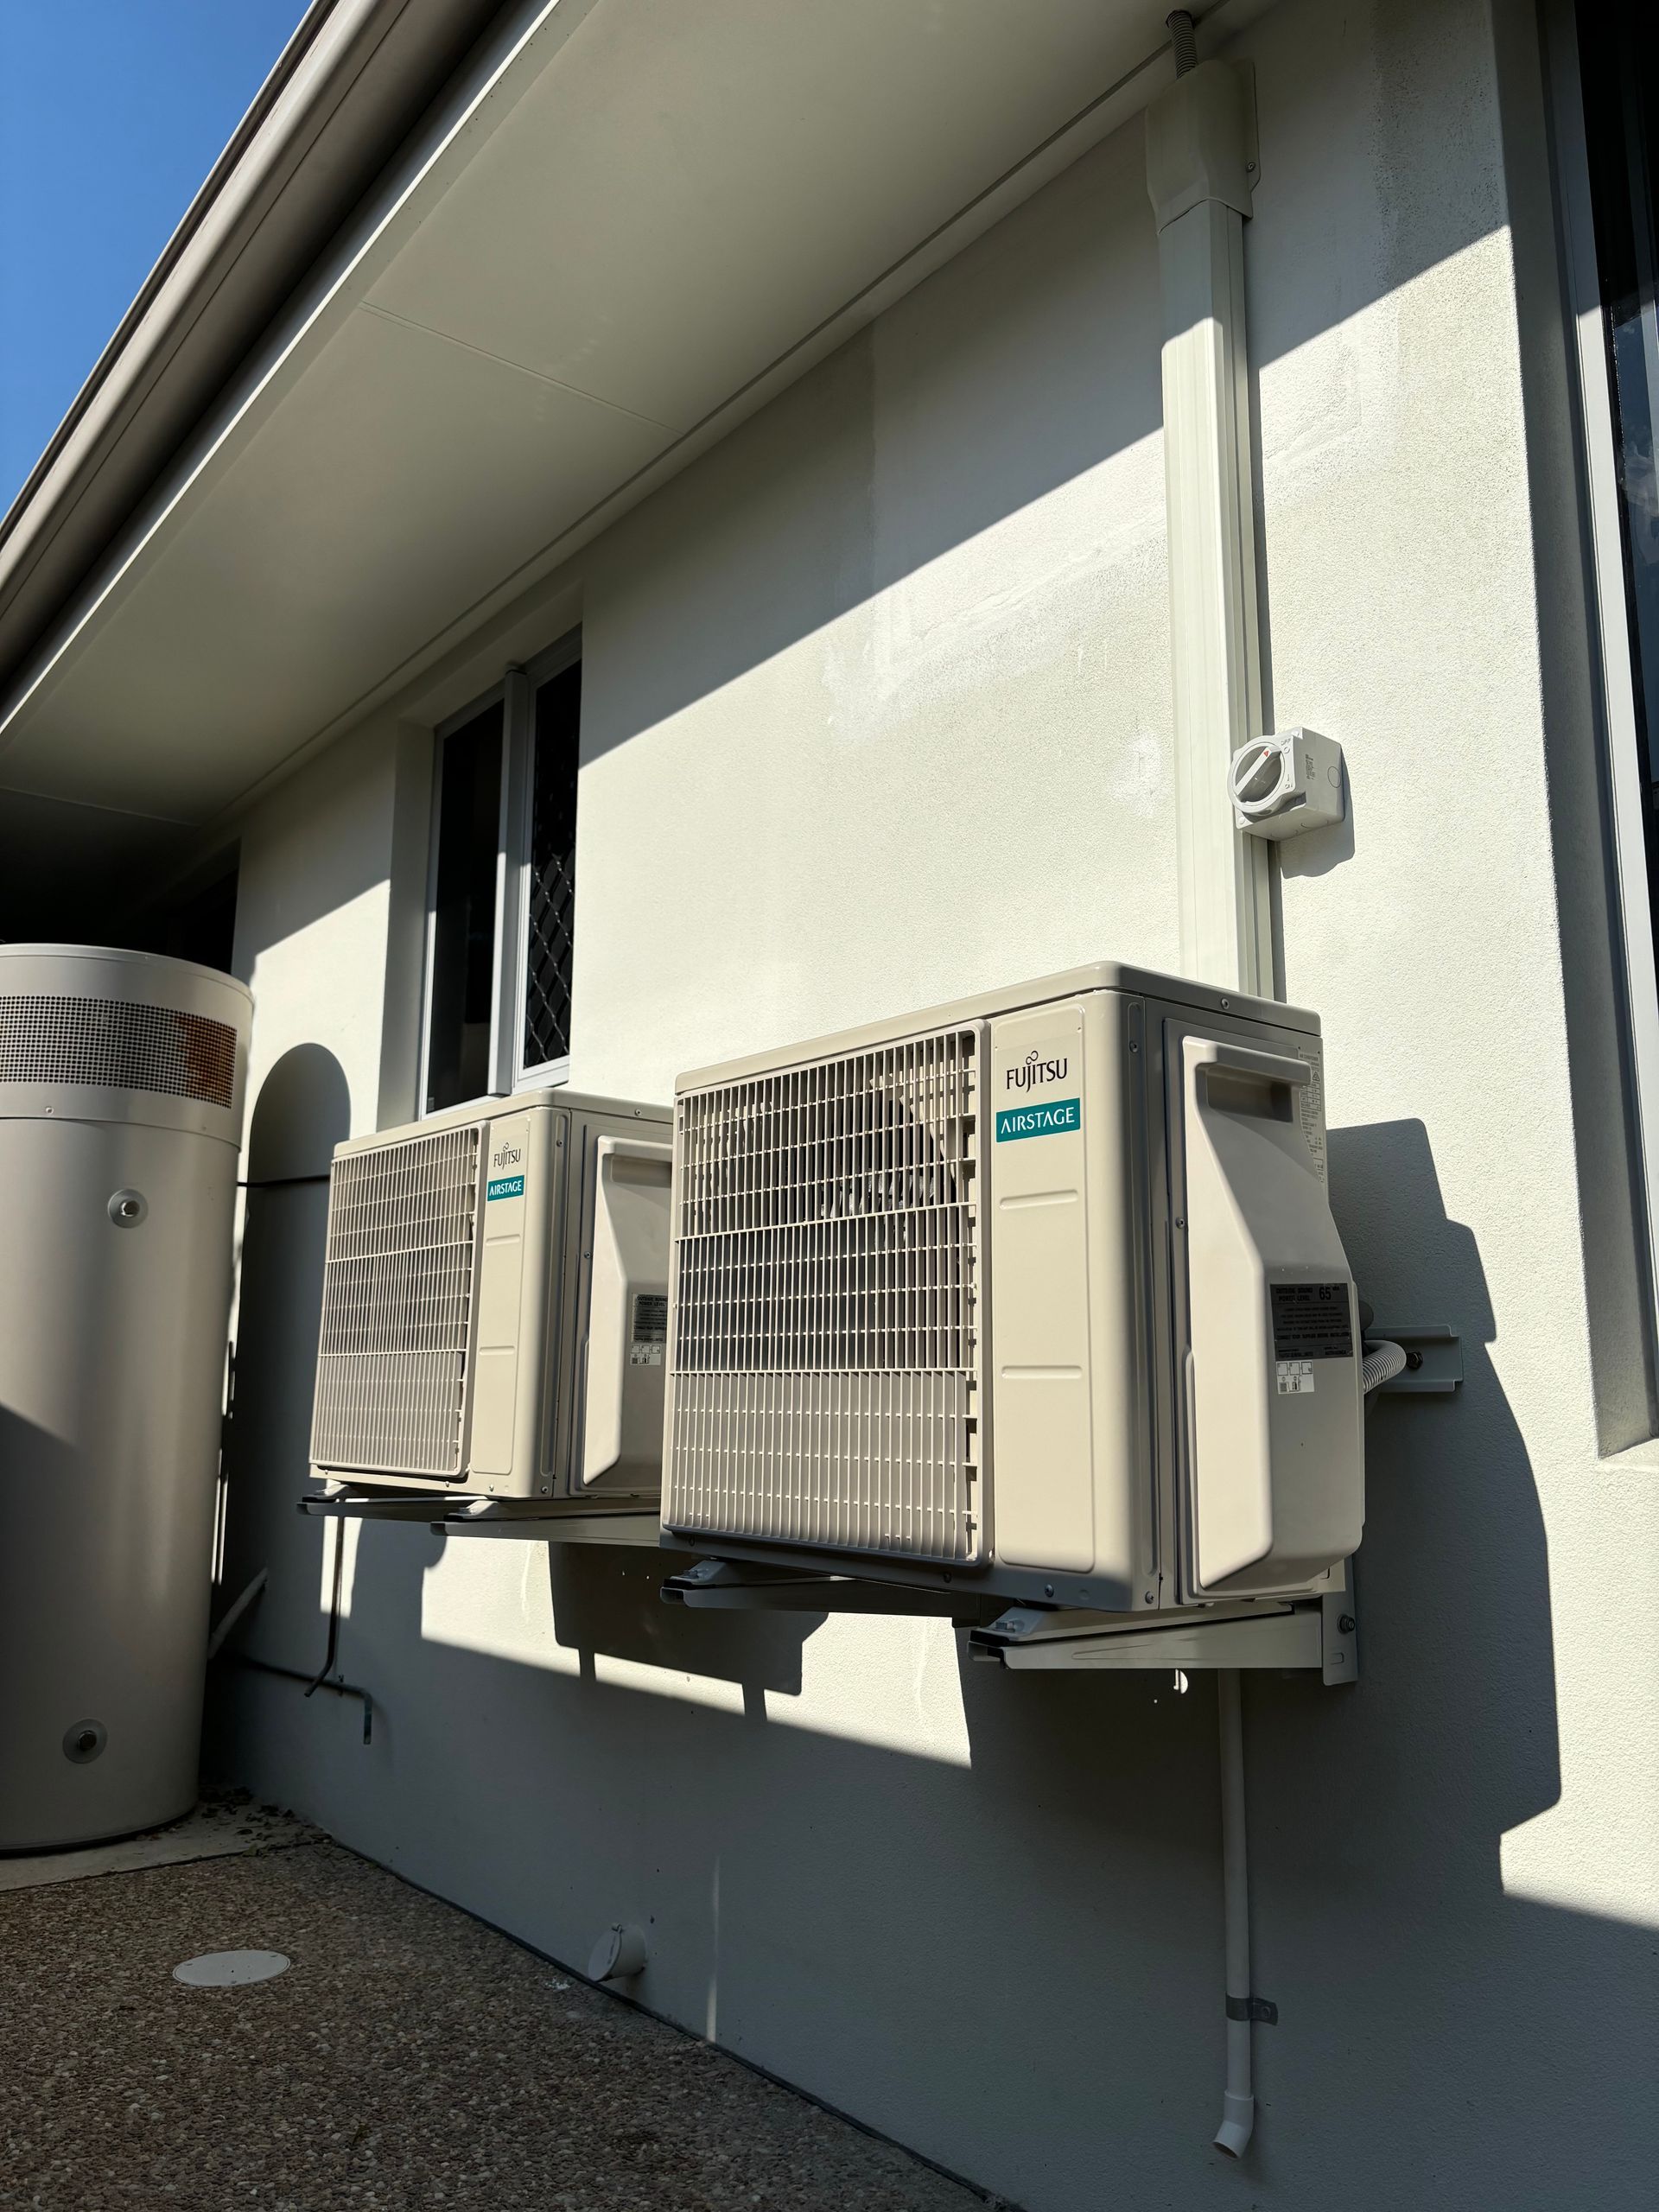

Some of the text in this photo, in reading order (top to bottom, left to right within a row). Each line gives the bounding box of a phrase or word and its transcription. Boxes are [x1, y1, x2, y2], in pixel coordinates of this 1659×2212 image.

[1006, 1051, 1068, 1093] FUJITSU
[1001, 1107, 1075, 1135] AIRSTAGE
[493, 1141, 521, 1170] FUJITSU
[489, 1180, 522, 1197] AIRSTAGE
[1319, 1287, 1332, 1300] 65
